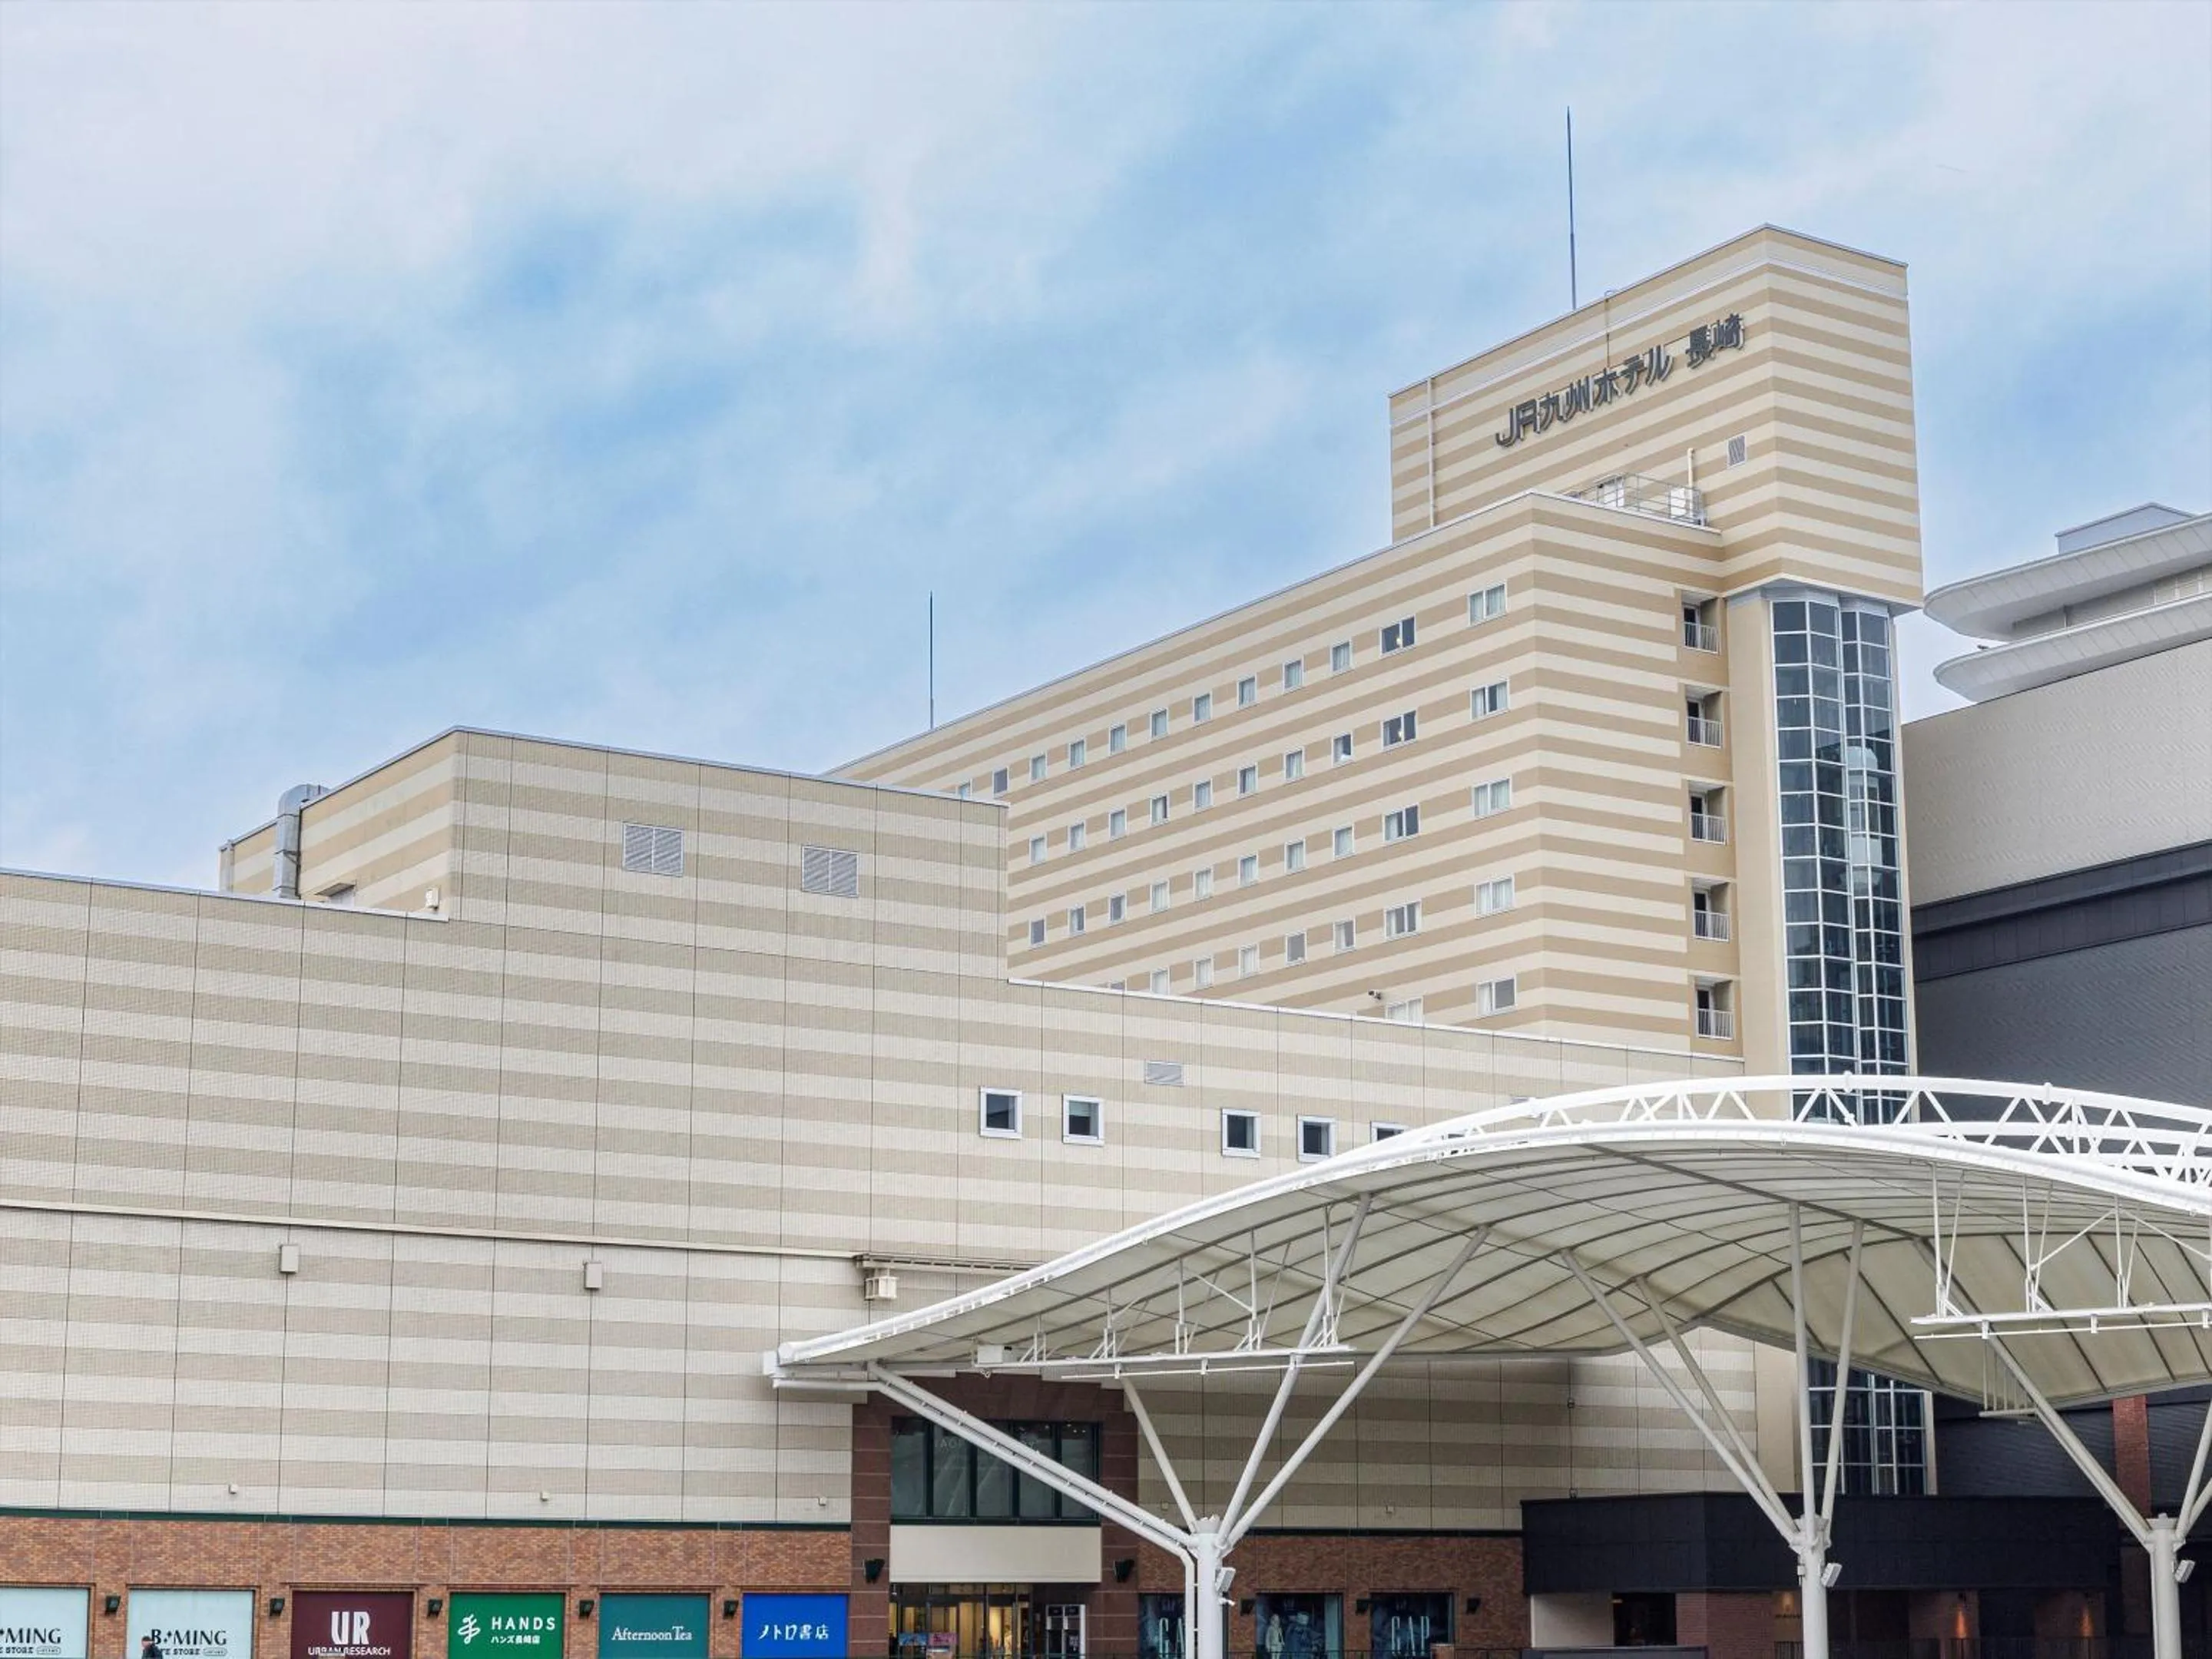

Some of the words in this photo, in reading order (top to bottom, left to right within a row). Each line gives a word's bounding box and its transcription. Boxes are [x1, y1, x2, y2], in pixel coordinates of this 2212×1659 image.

[1495, 344, 1674, 448] JR九州ホテル
[1685, 313, 1745, 369] 長崎
[331, 1611, 370, 1645] UR
[492, 1616, 556, 1631] HANDS
[611, 1626, 673, 1641] Afternoon
[672, 1625, 693, 1641] Tea
[1158, 1617, 1186, 1658] GA
[1391, 1615, 1430, 1657] GAP
